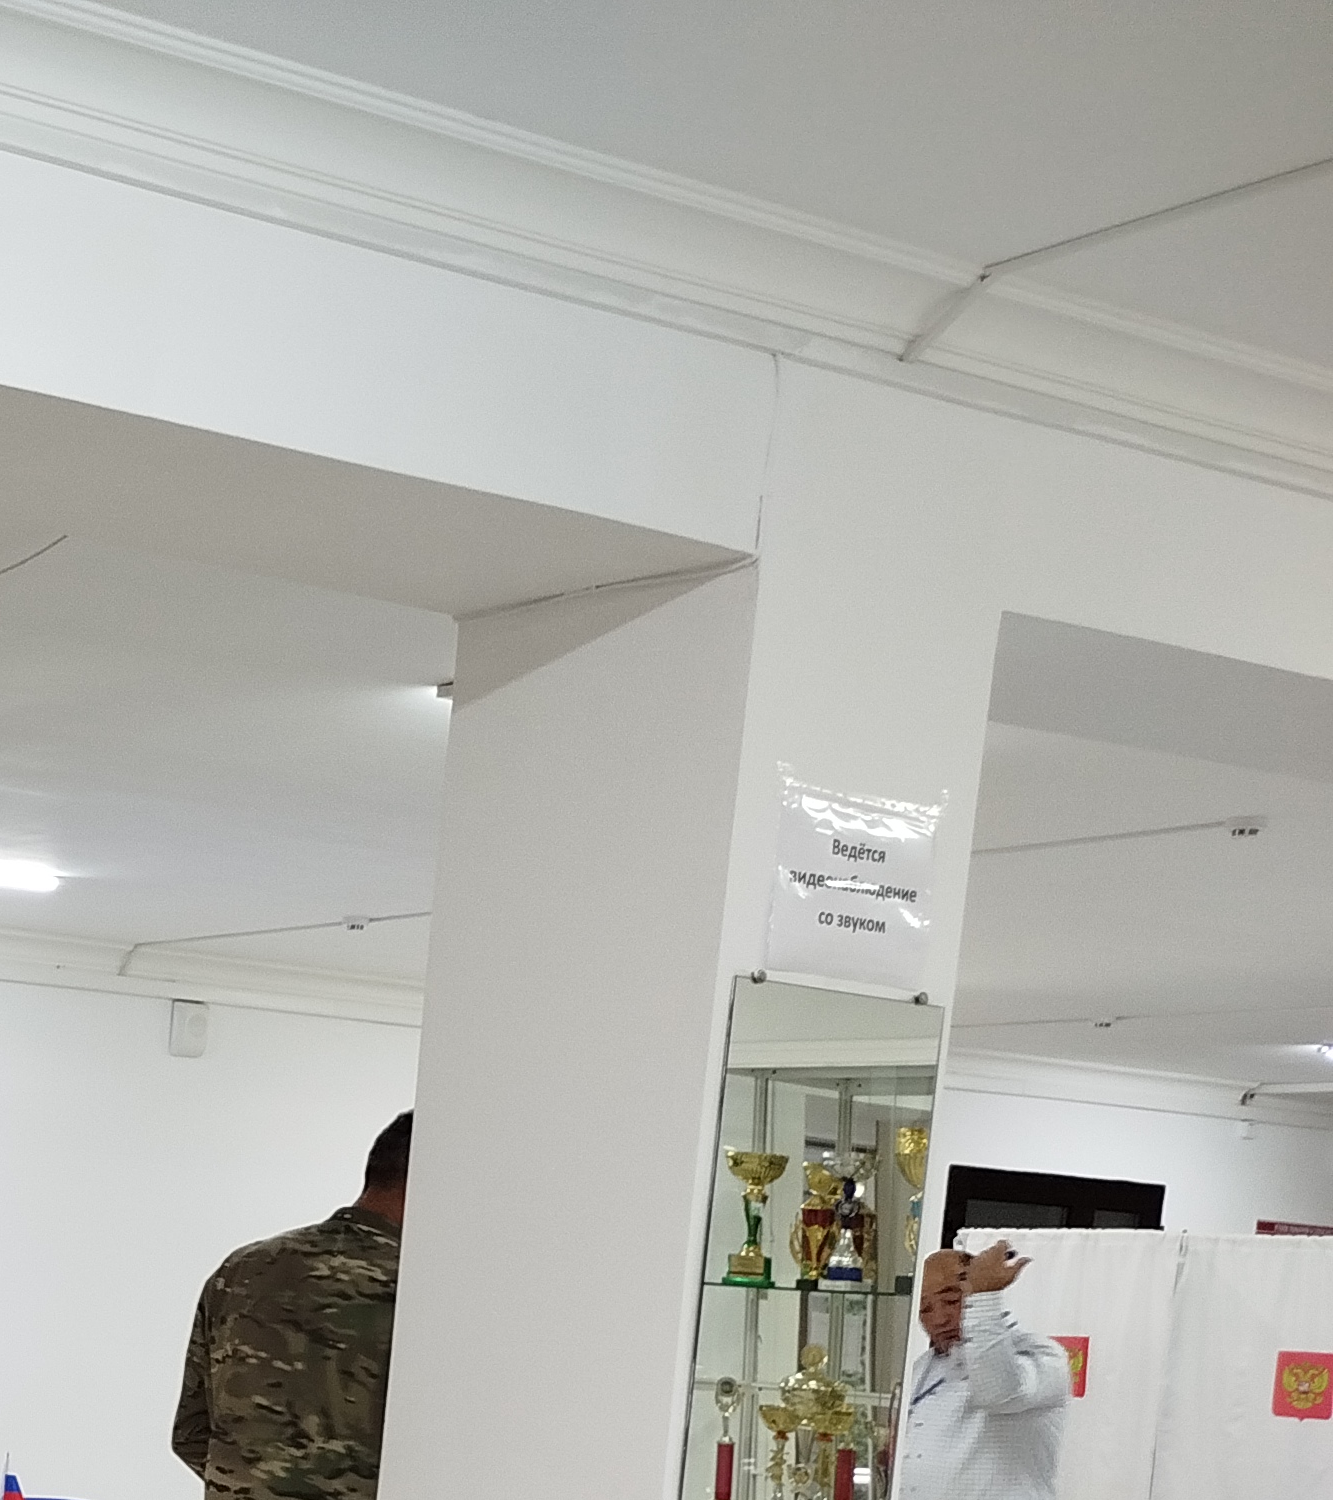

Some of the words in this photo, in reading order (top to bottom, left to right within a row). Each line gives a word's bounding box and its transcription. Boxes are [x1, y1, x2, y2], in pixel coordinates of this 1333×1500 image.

[832, 838, 885, 863] Ведётся
[818, 911, 833, 925] со
[836, 914, 886, 933] звуком
